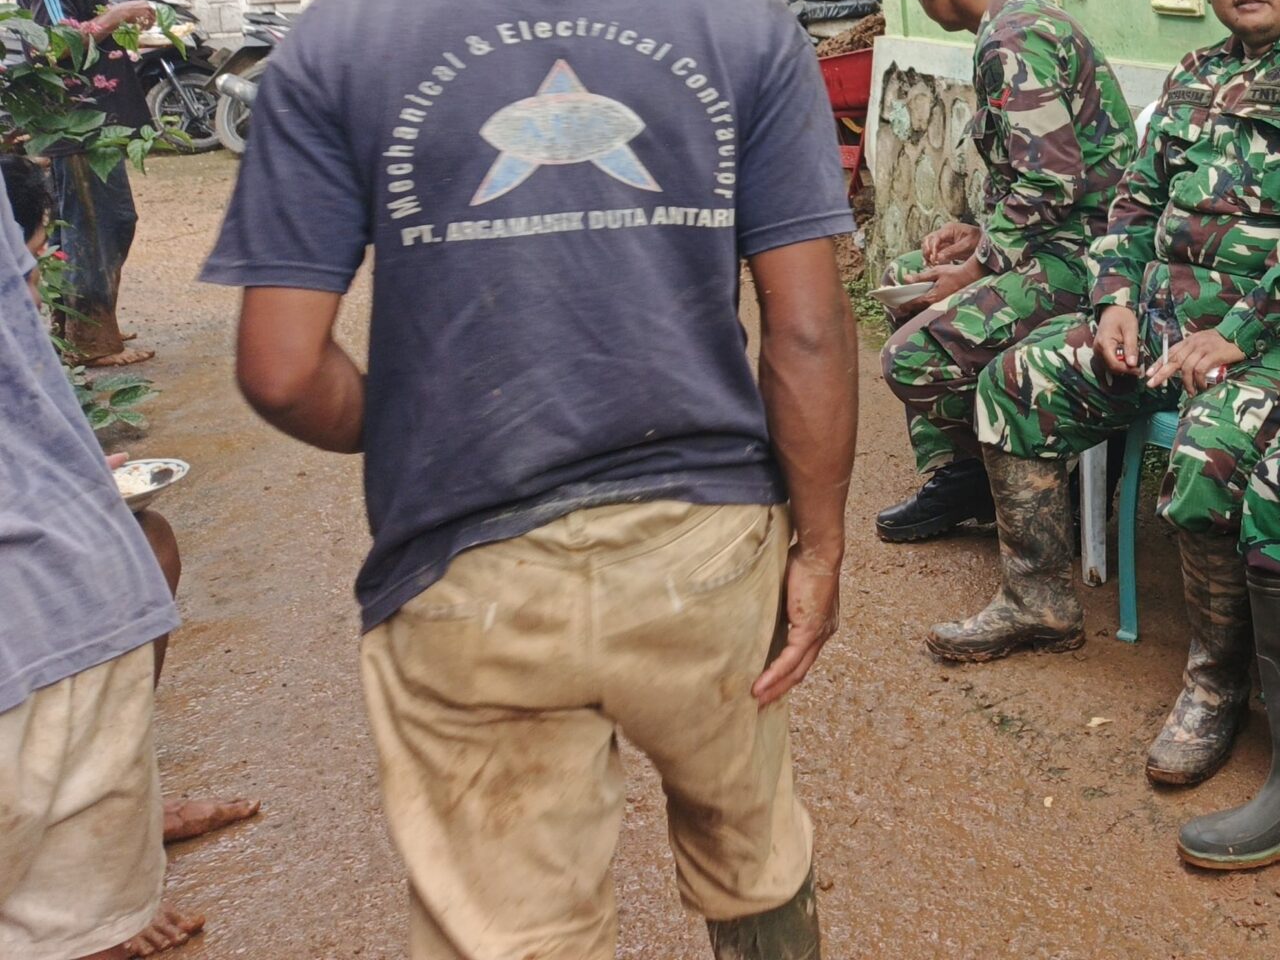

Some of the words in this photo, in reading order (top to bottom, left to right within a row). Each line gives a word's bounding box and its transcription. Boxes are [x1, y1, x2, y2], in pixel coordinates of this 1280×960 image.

[464, 35, 495, 55] &
[496, 17, 673, 61] Electrical
[402, 224, 442, 246] PT.
[588, 208, 648, 229] DUTA
